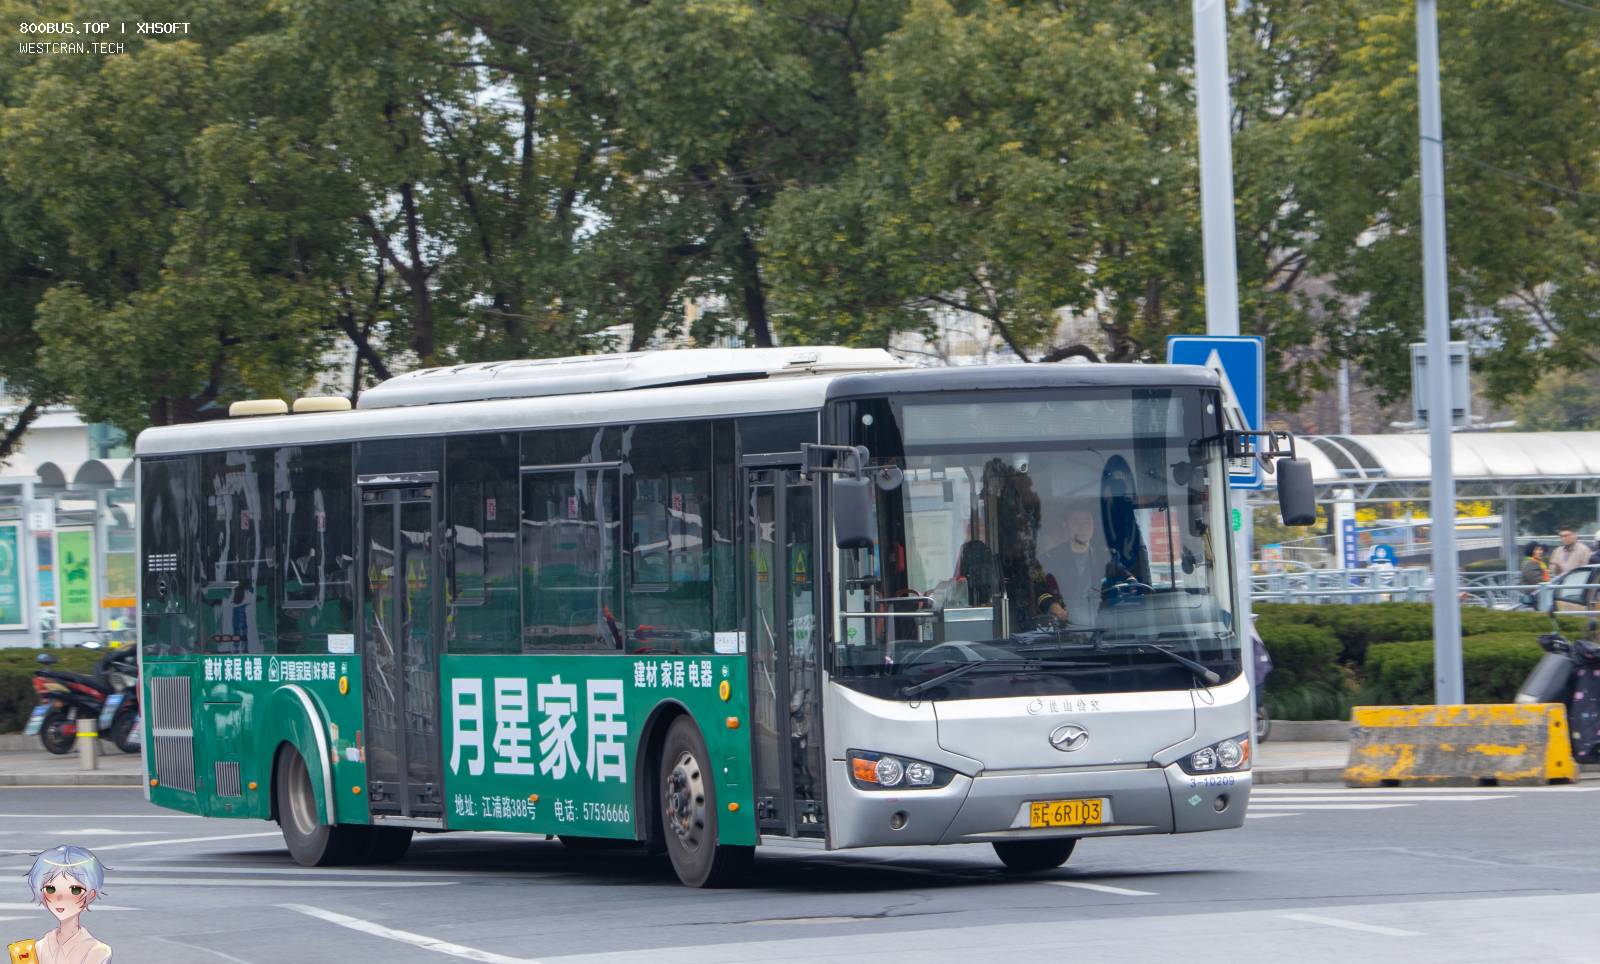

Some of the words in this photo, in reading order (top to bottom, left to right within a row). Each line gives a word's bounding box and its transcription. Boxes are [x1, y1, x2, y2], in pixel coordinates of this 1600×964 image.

[204, 657, 223, 682] 建材
[224, 657, 242, 682] 家居
[244, 657, 263, 682] 电器
[280, 660, 312, 682] 月星家居
[313, 661, 336, 682] 好家居
[634, 660, 658, 688] 建材
[661, 660, 686, 688] 家居
[688, 660, 713, 688] 电器
[450, 674, 628, 784] 月星家居
[1190, 776, 1235, 788] 3-10209
